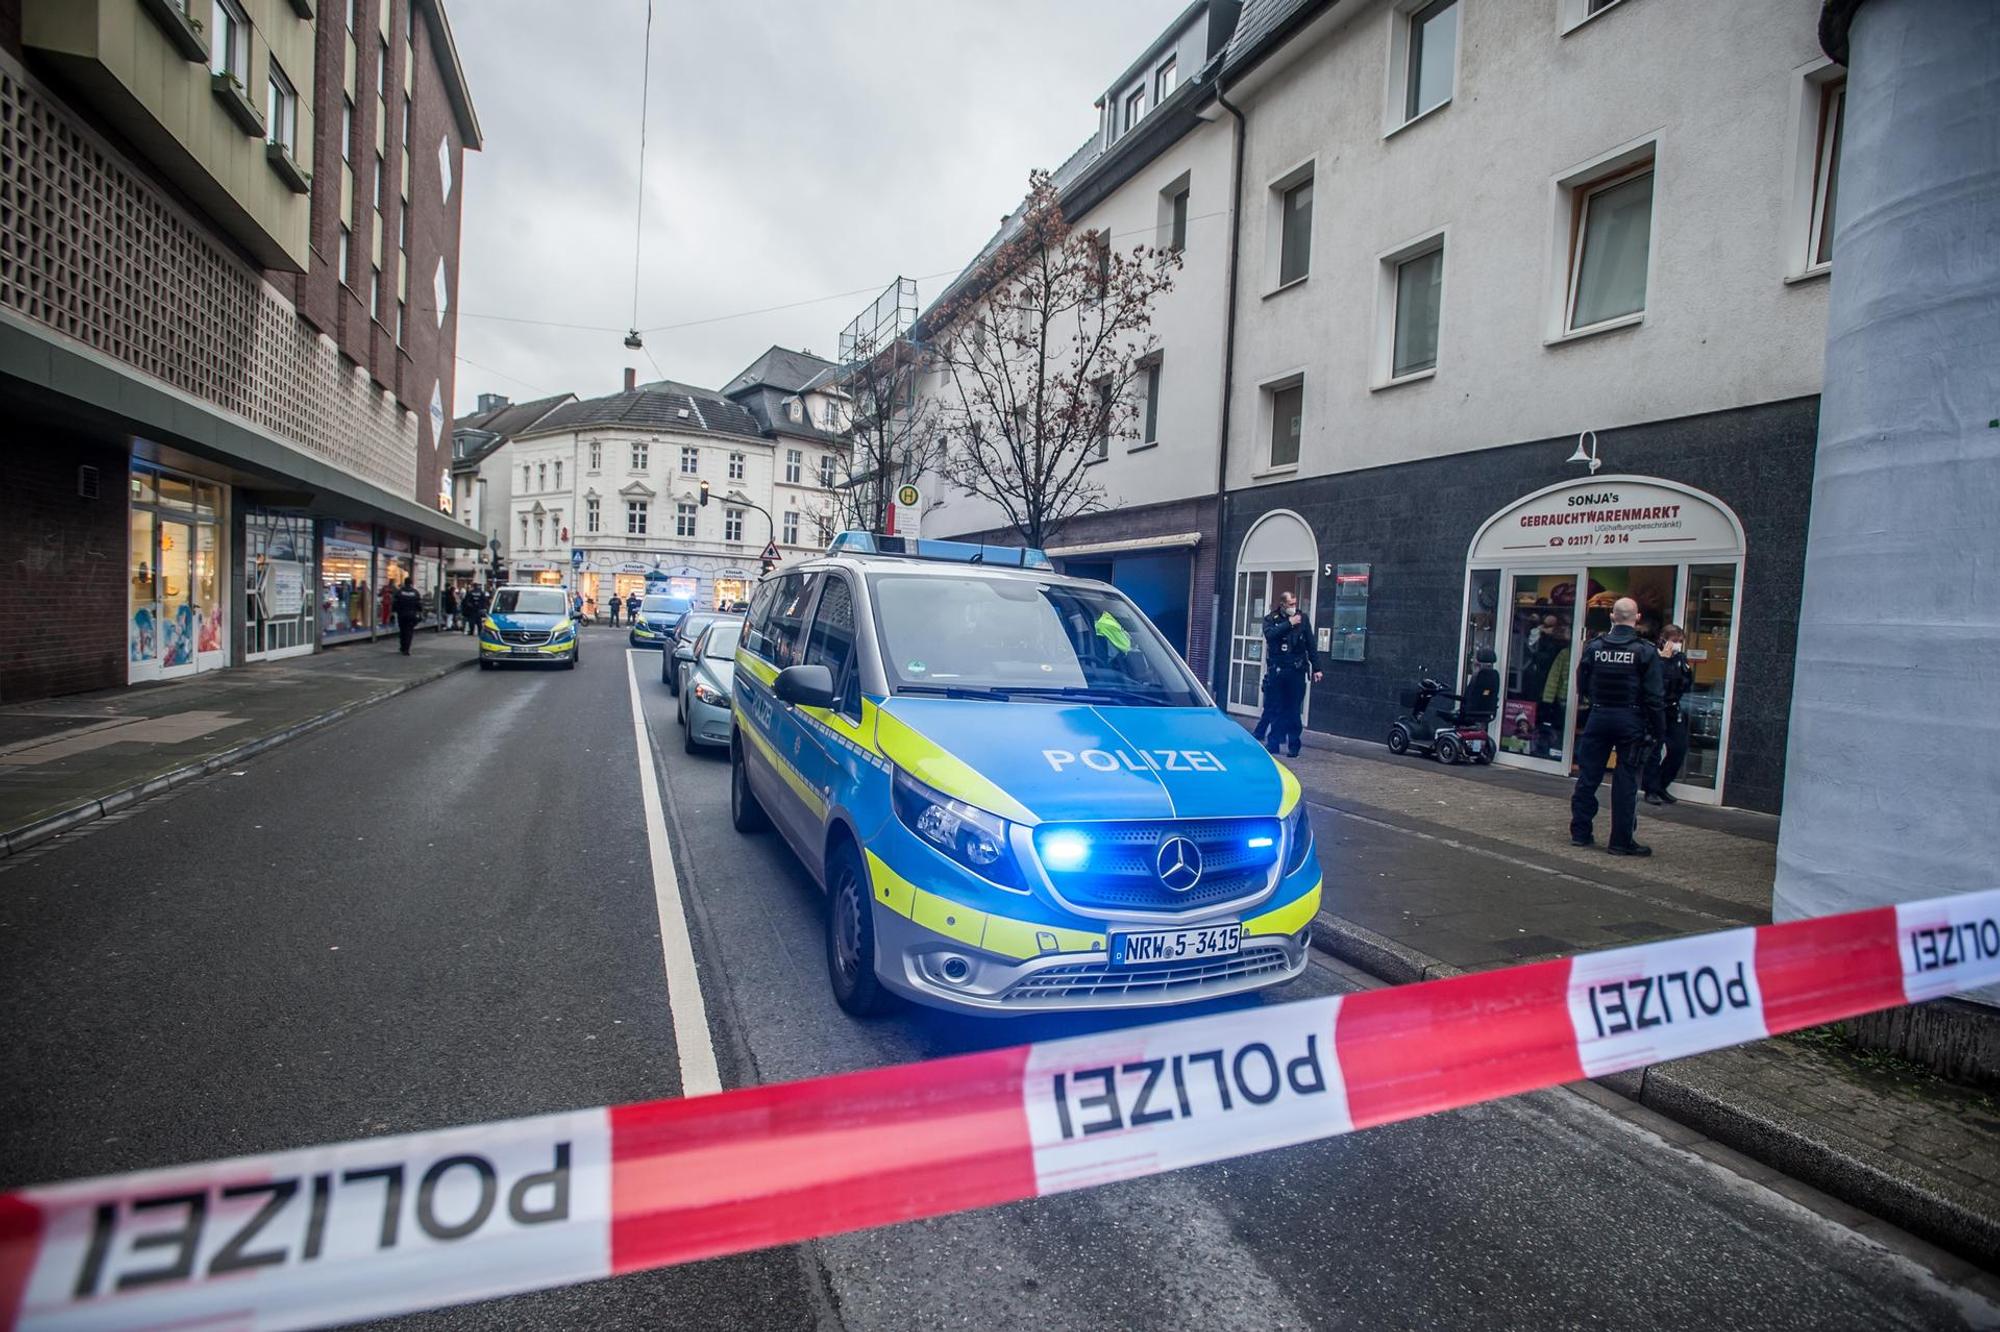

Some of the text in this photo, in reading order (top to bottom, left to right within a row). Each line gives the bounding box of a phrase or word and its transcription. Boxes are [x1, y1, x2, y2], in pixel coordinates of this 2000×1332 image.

[904, 490, 914, 502] H
[1567, 493, 1619, 506] SONJA's
[1520, 505, 1681, 528] GEBRAUCHTWARENMARKT
[1568, 534, 1594, 546] 02171
[1594, 651, 1635, 664] POLIZEI
[1042, 749, 1227, 772] POLIZEI
[1125, 936, 1165, 960] NRW
[1588, 961, 1749, 1037] POLIZEI
[1054, 1034, 1326, 1139] POLIZEI
[71, 1142, 571, 1300] POLIZEI
